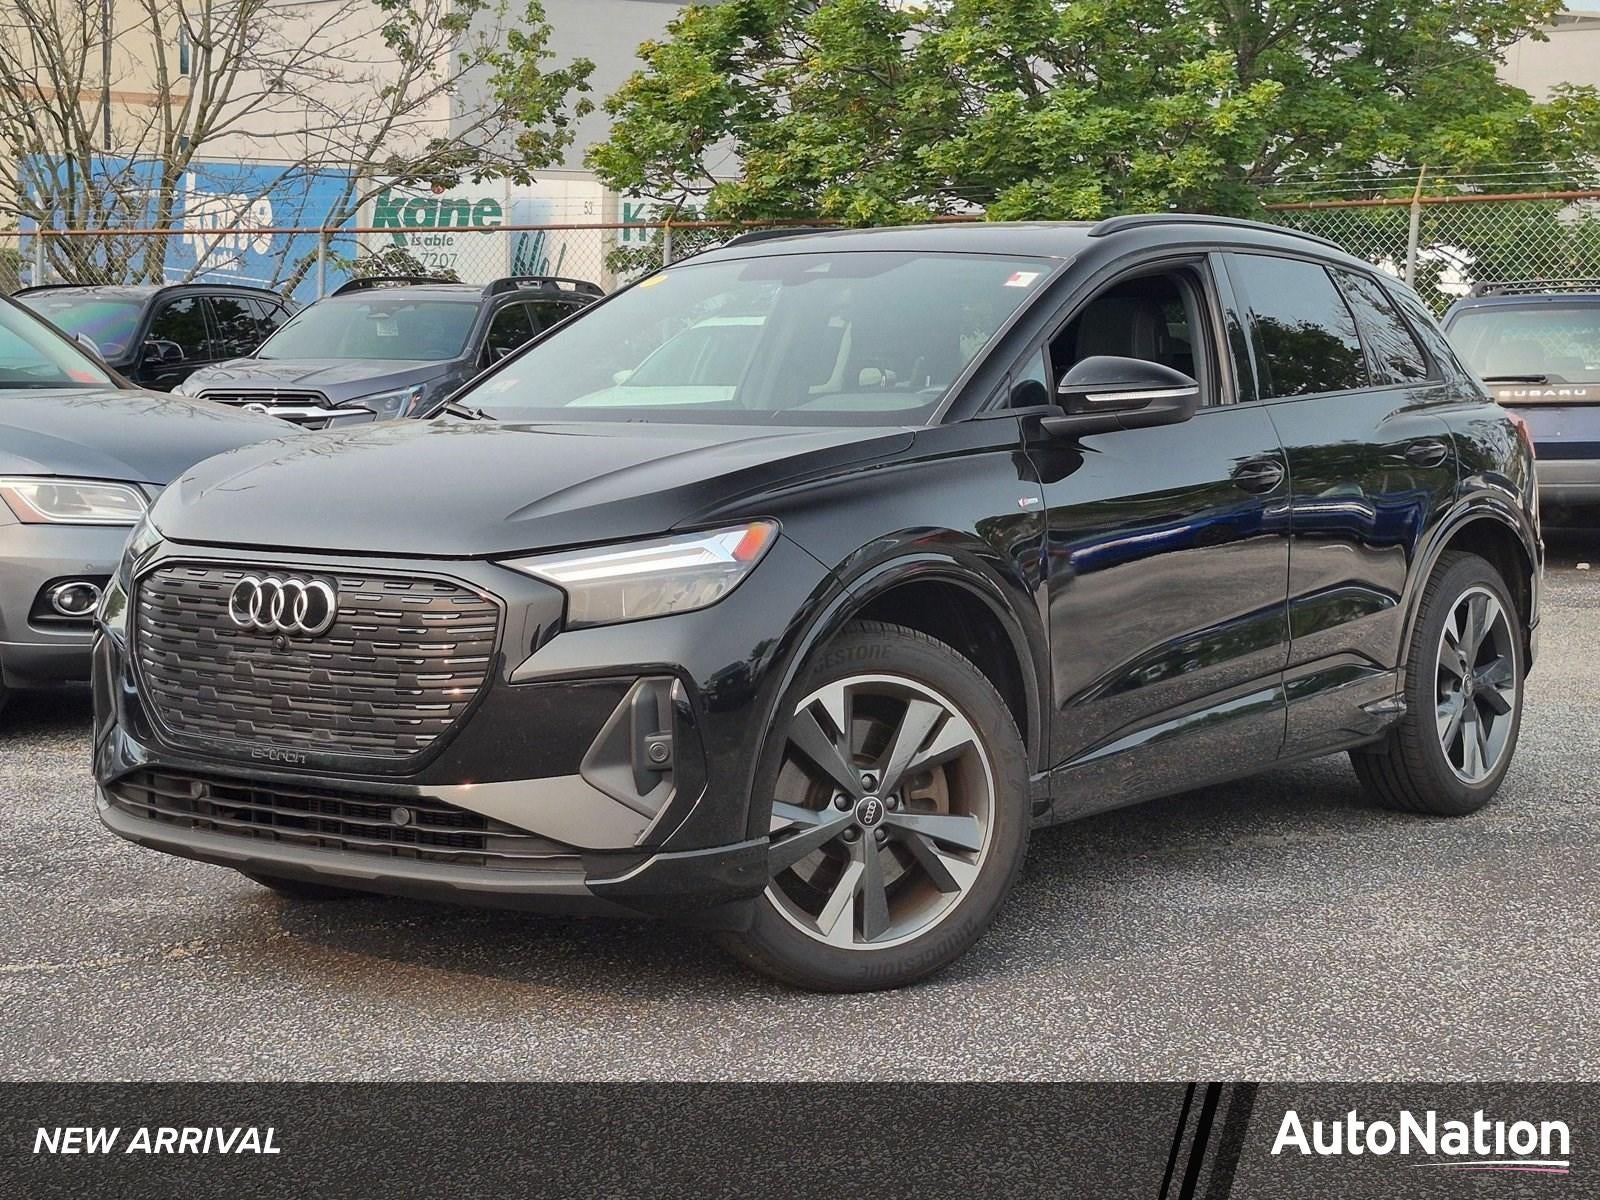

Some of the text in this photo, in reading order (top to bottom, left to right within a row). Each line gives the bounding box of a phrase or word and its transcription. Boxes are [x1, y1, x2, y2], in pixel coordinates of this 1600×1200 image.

[372, 185, 503, 247] kane
[411, 231, 454, 247] is able
[420, 252, 458, 269] 7207
[1498, 389, 1587, 397] SUBARU
